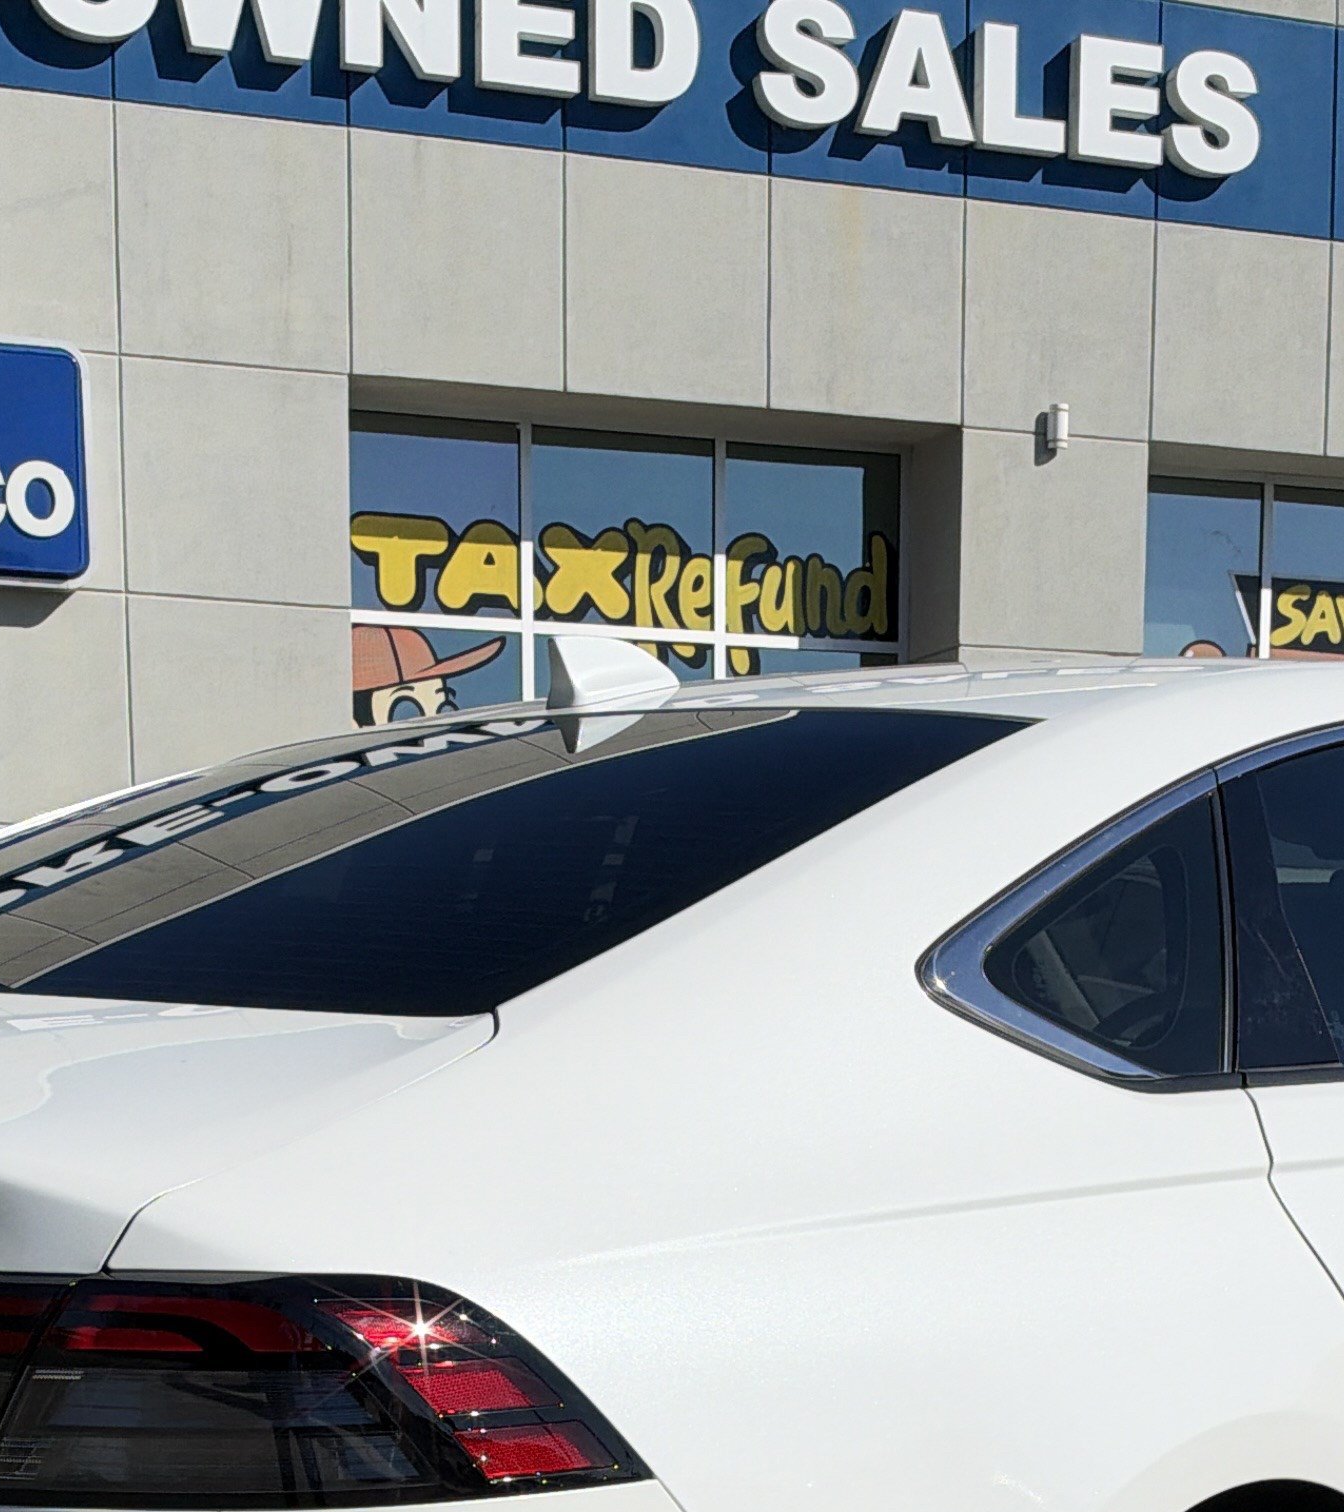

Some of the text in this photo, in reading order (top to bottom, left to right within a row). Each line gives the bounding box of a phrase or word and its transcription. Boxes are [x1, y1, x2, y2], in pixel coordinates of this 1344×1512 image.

[753, 0, 1261, 178] SALES
[350, 513, 889, 674] TAX Refund
